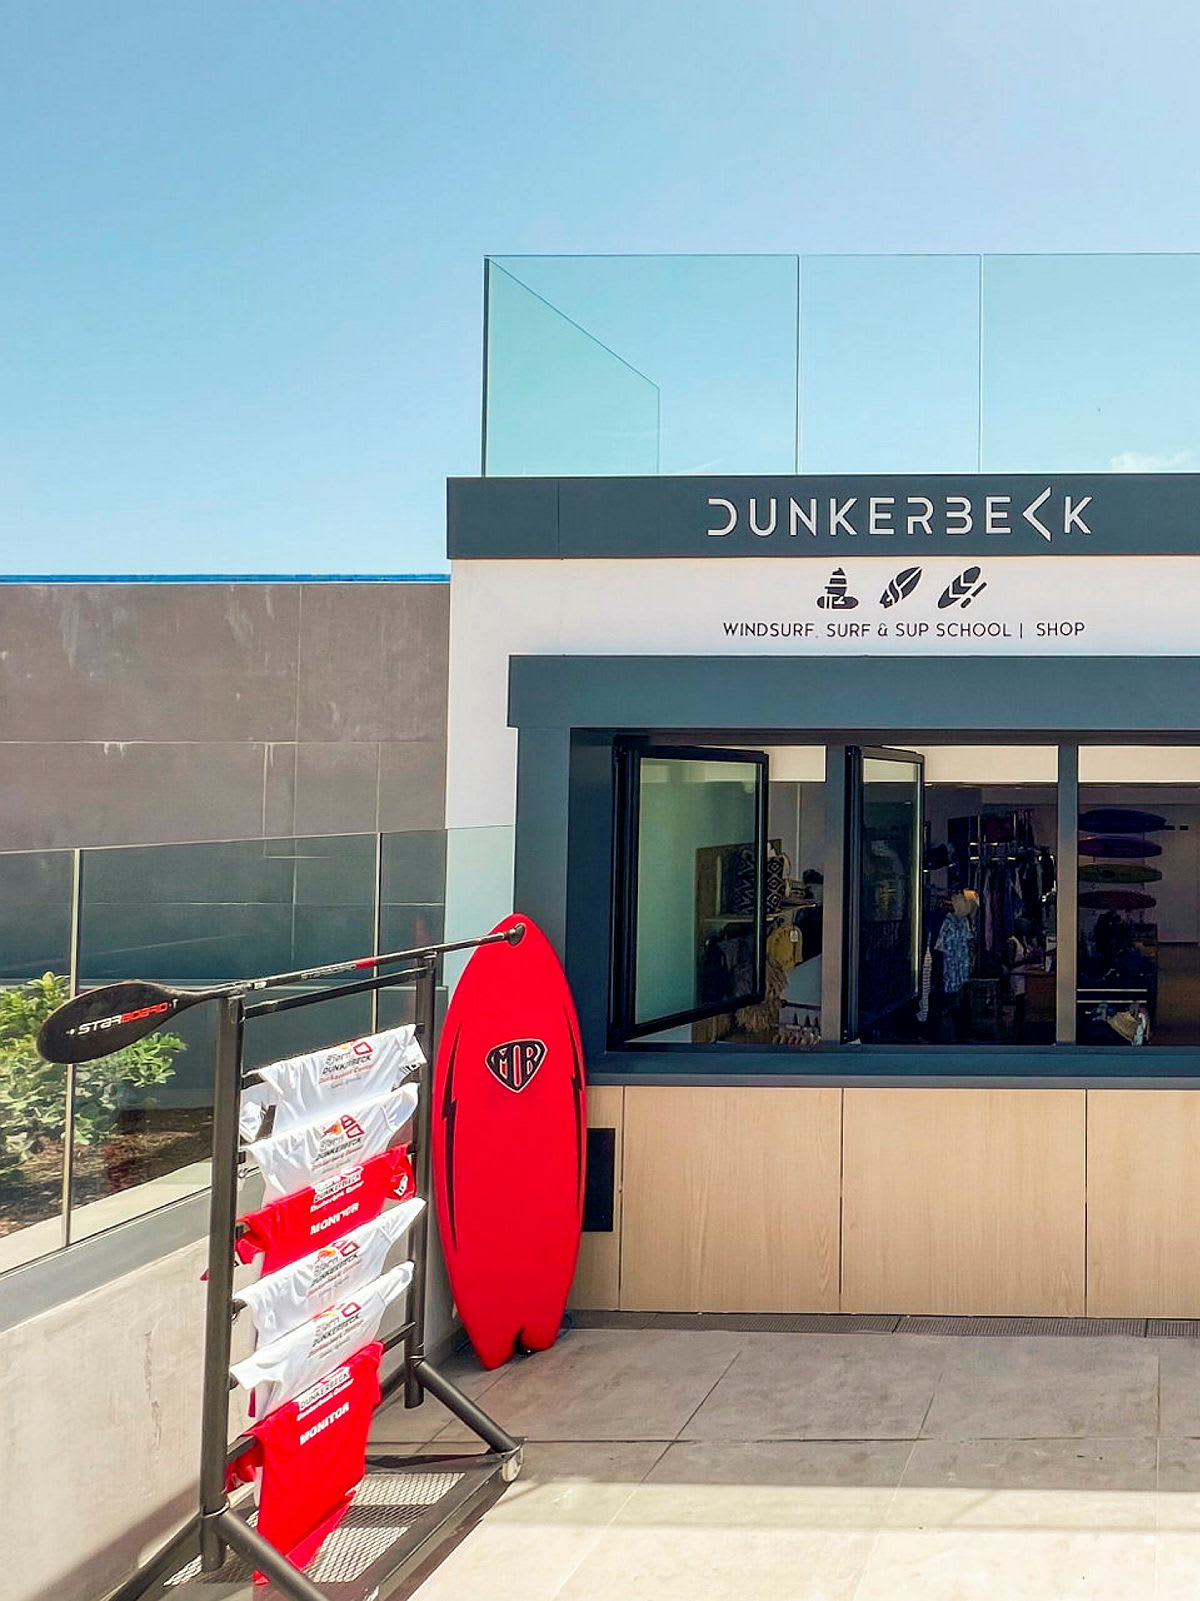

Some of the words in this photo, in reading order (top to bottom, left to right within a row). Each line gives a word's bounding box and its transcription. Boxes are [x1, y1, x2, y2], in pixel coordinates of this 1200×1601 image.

[707, 486, 1093, 543] DUNKERBECK
[827, 623, 871, 637] SURF
[877, 623, 889, 637] &
[895, 622, 929, 637] SUP
[936, 622, 1012, 637] SCHOOL
[1036, 621, 1086, 637] SHOP
[299, 1402, 350, 1446] MONITOR
